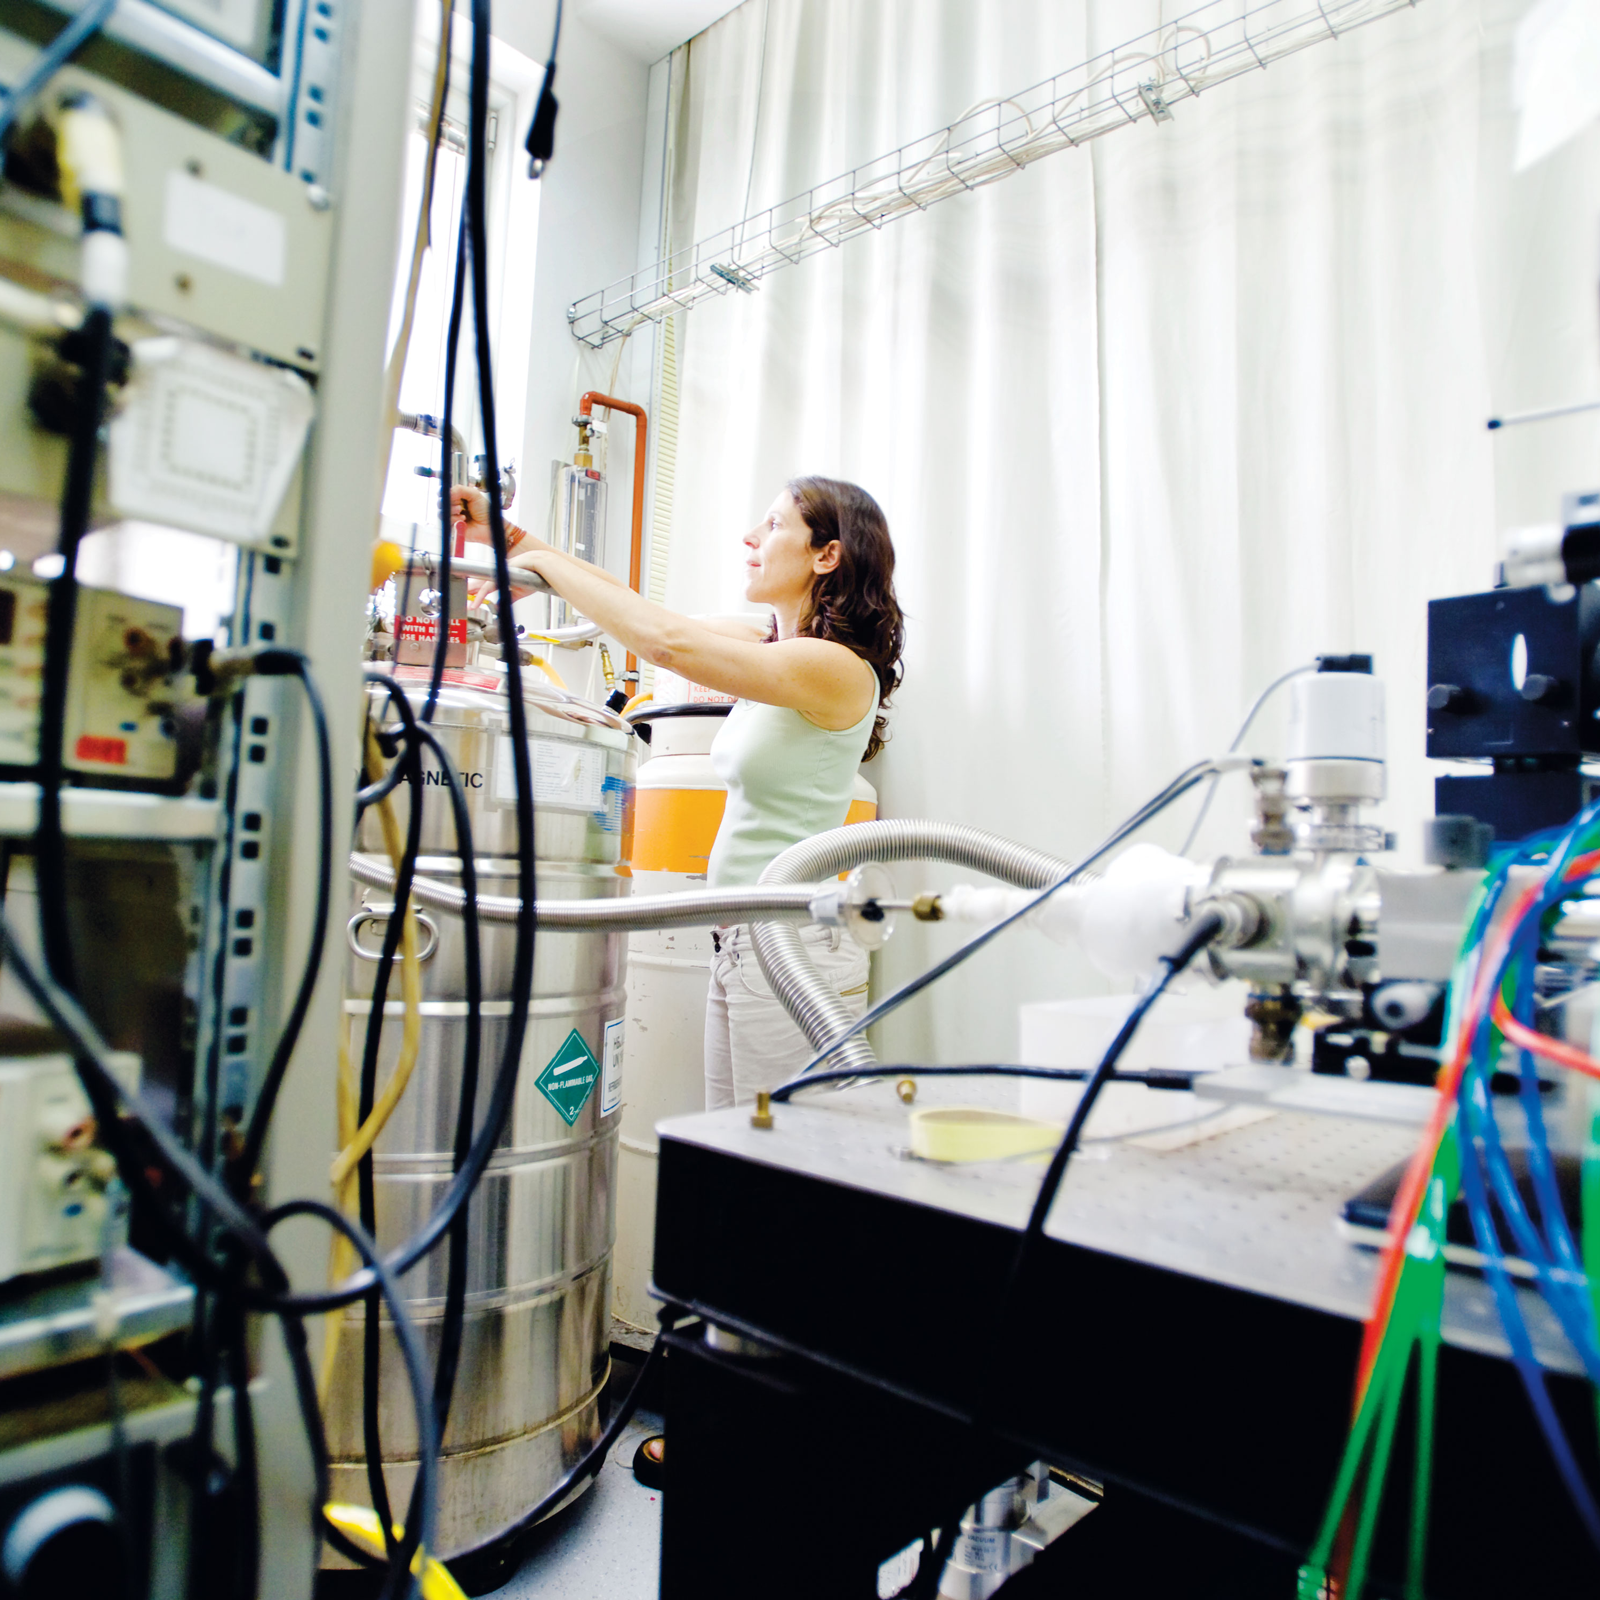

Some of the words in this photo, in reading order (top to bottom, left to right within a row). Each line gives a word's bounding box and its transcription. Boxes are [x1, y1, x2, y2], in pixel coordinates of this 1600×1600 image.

[416, 616, 436, 625] NOT
[402, 624, 426, 633] WITH
[418, 635, 461, 644] HANES
[693, 696, 705, 704] DO
[707, 696, 725, 704] NOT
[569, 1106, 575, 1115] 2
[967, 1534, 996, 1544] VACUUM
